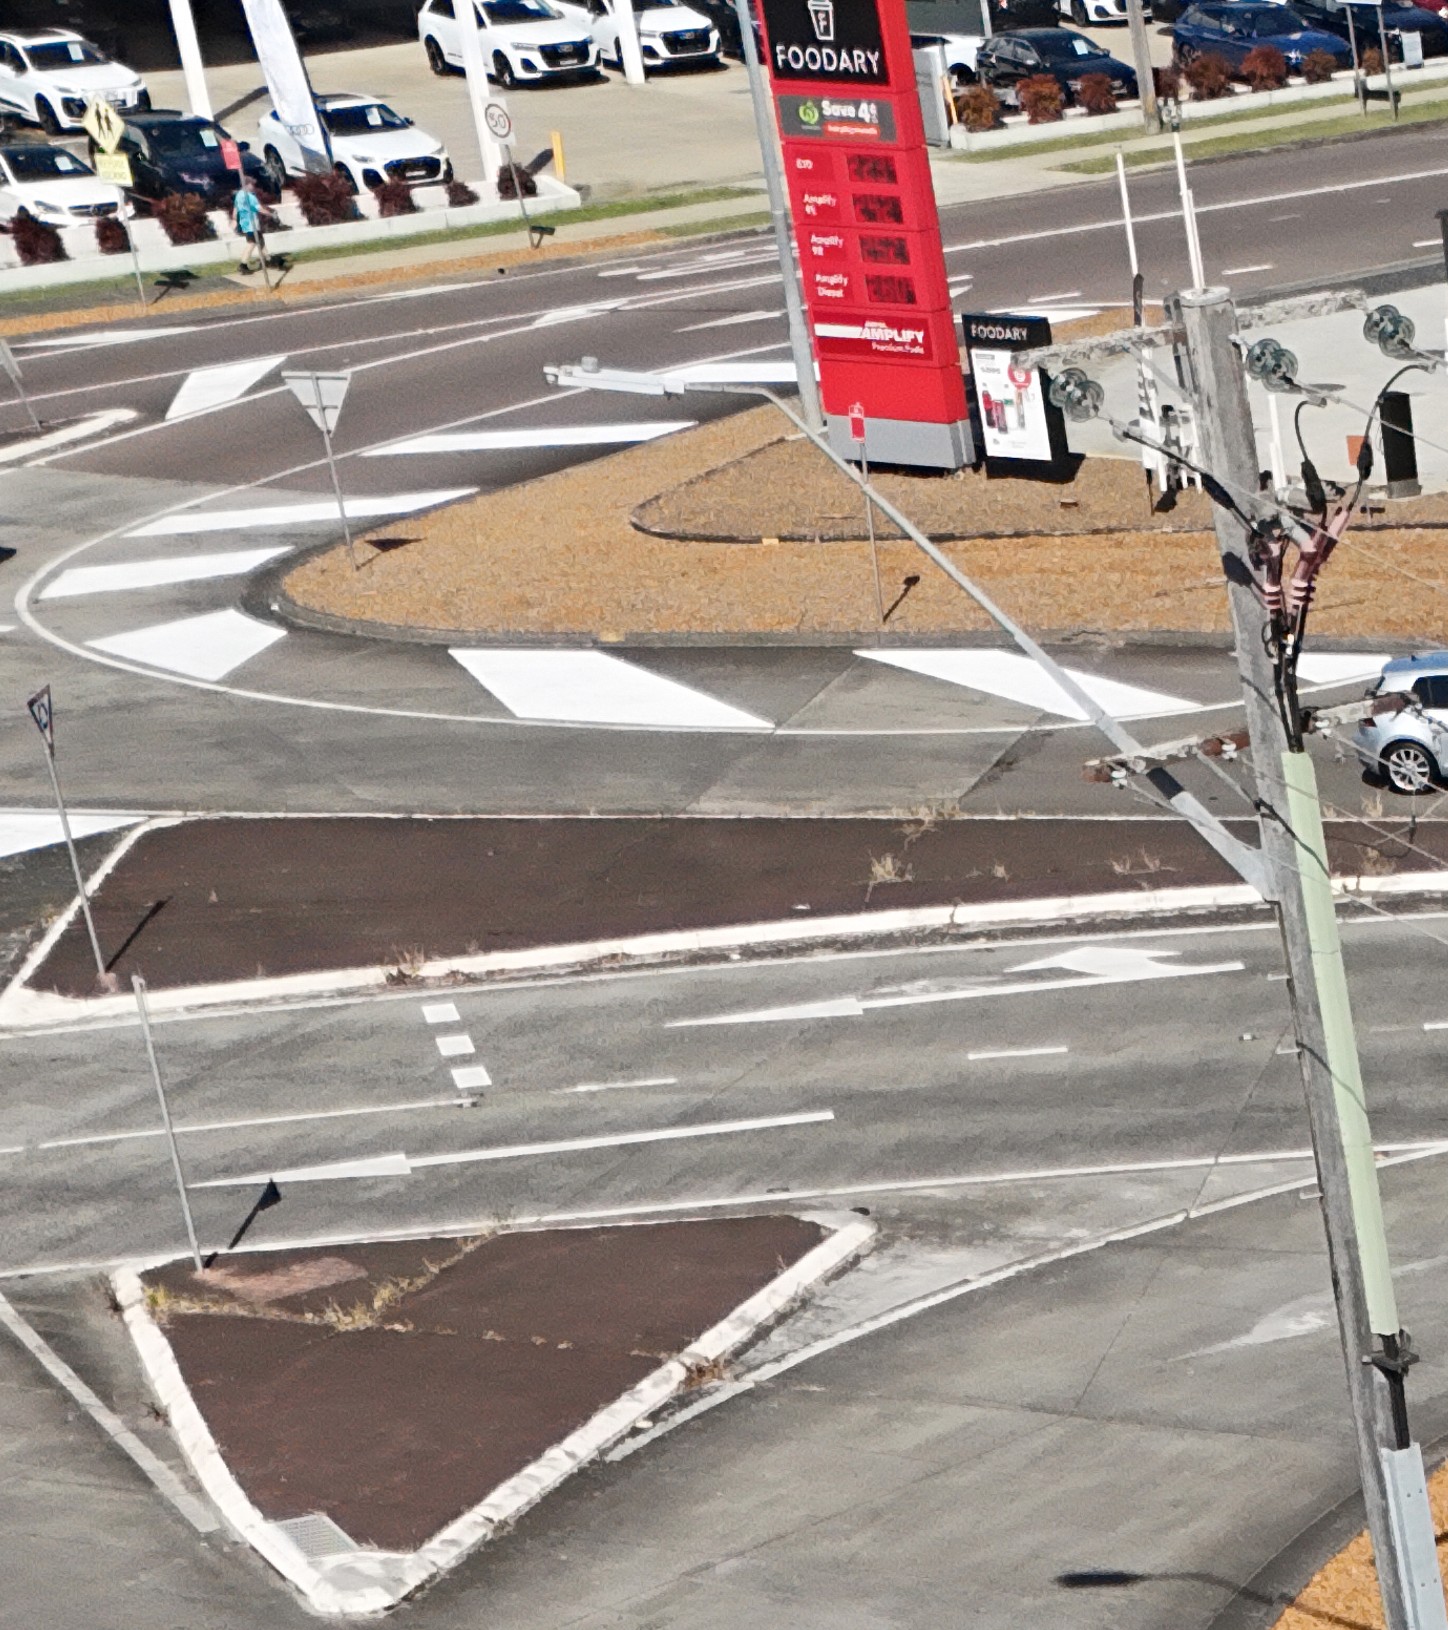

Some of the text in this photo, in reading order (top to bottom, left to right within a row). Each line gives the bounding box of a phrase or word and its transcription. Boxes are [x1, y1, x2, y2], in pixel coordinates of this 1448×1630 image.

[776, 44, 880, 75] FOODARY
[821, 100, 856, 118] Save
[860, 328, 925, 344] AMPLIFY
[971, 323, 1028, 340] FOODARY
